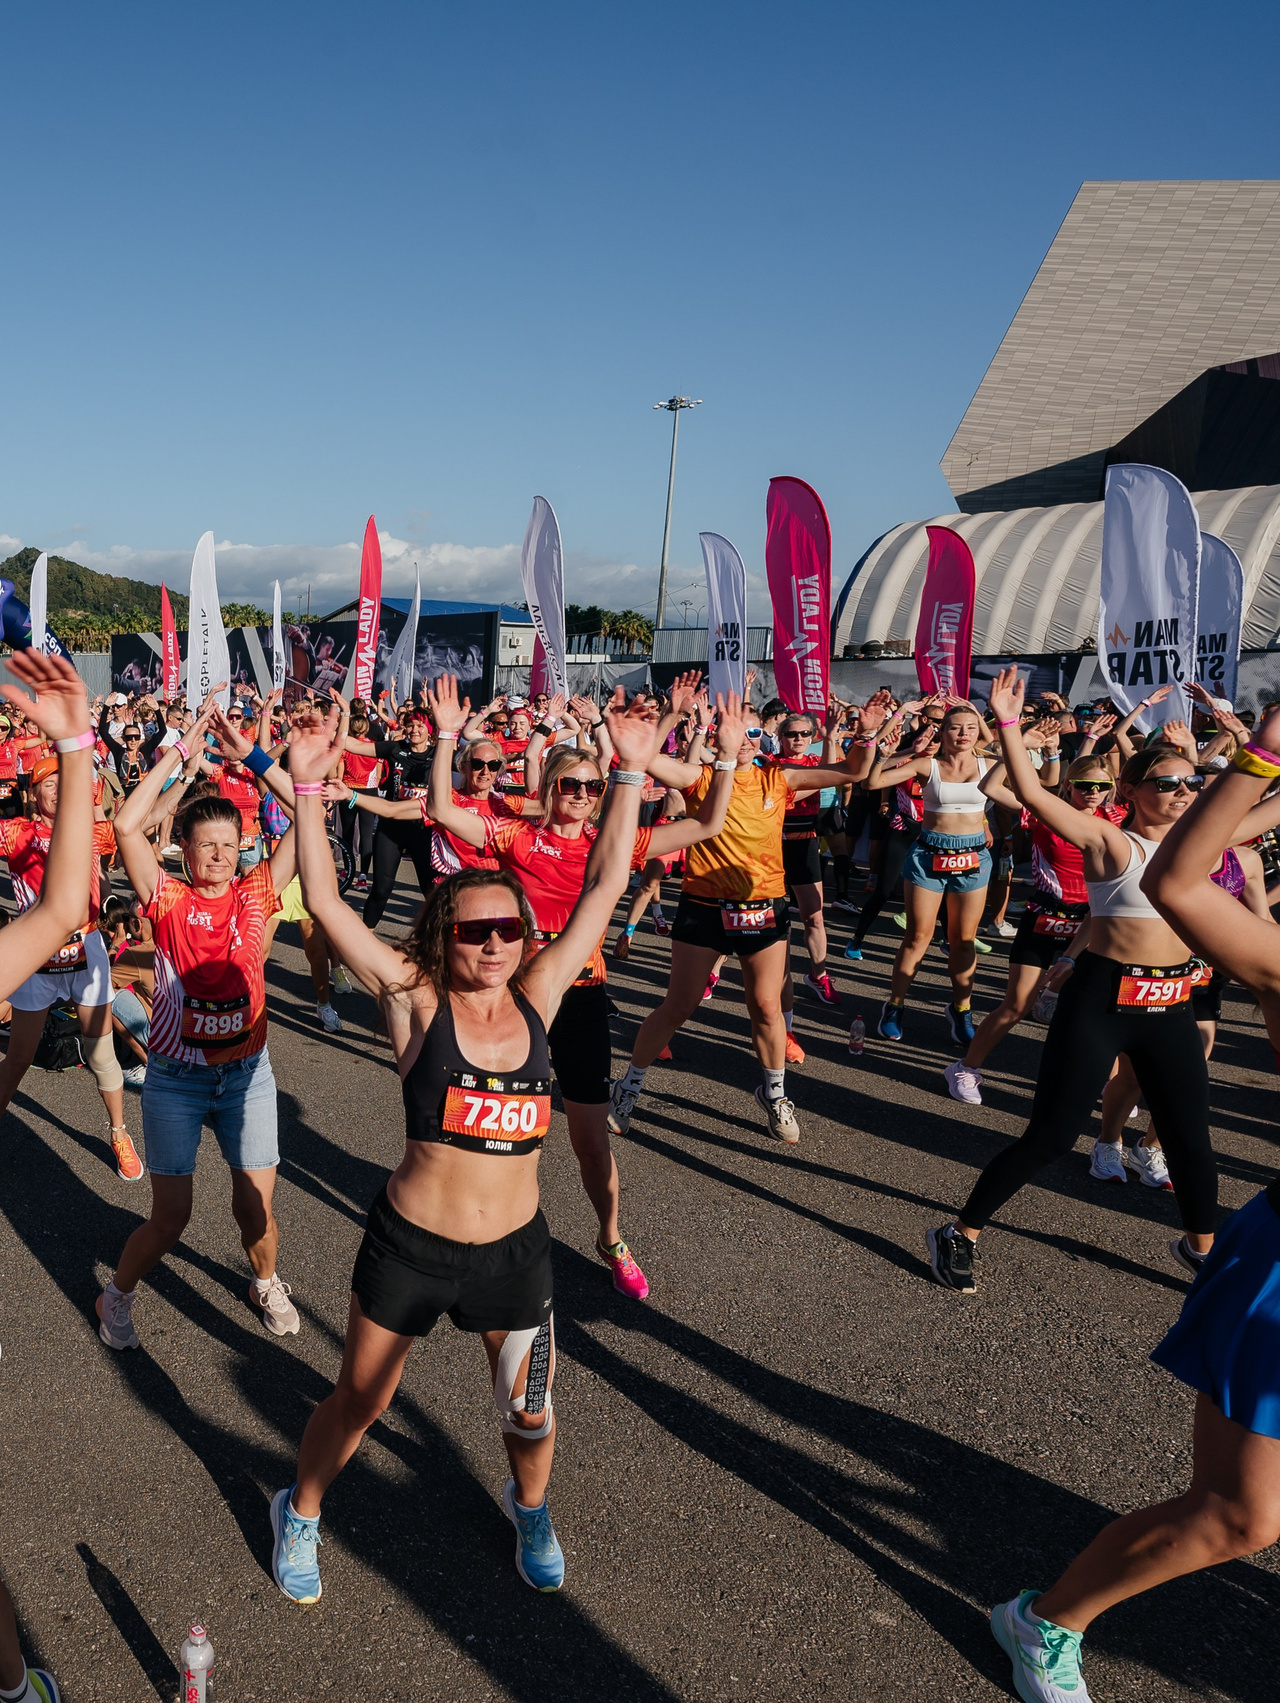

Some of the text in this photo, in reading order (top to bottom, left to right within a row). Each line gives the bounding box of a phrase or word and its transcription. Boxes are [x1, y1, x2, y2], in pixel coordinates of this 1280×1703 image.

[358, 596, 374, 643] LADY
[939, 855, 973, 869] 7601
[1044, 918, 1083, 934] 7657
[49, 946, 79, 964] 499
[1134, 980, 1184, 1002] 7591
[191, 1012, 243, 1035] 7898
[461, 1079, 478, 1089] LADY
[463, 1095, 538, 1132] 7260
[485, 1139, 513, 1152] ЮЛИЯ
